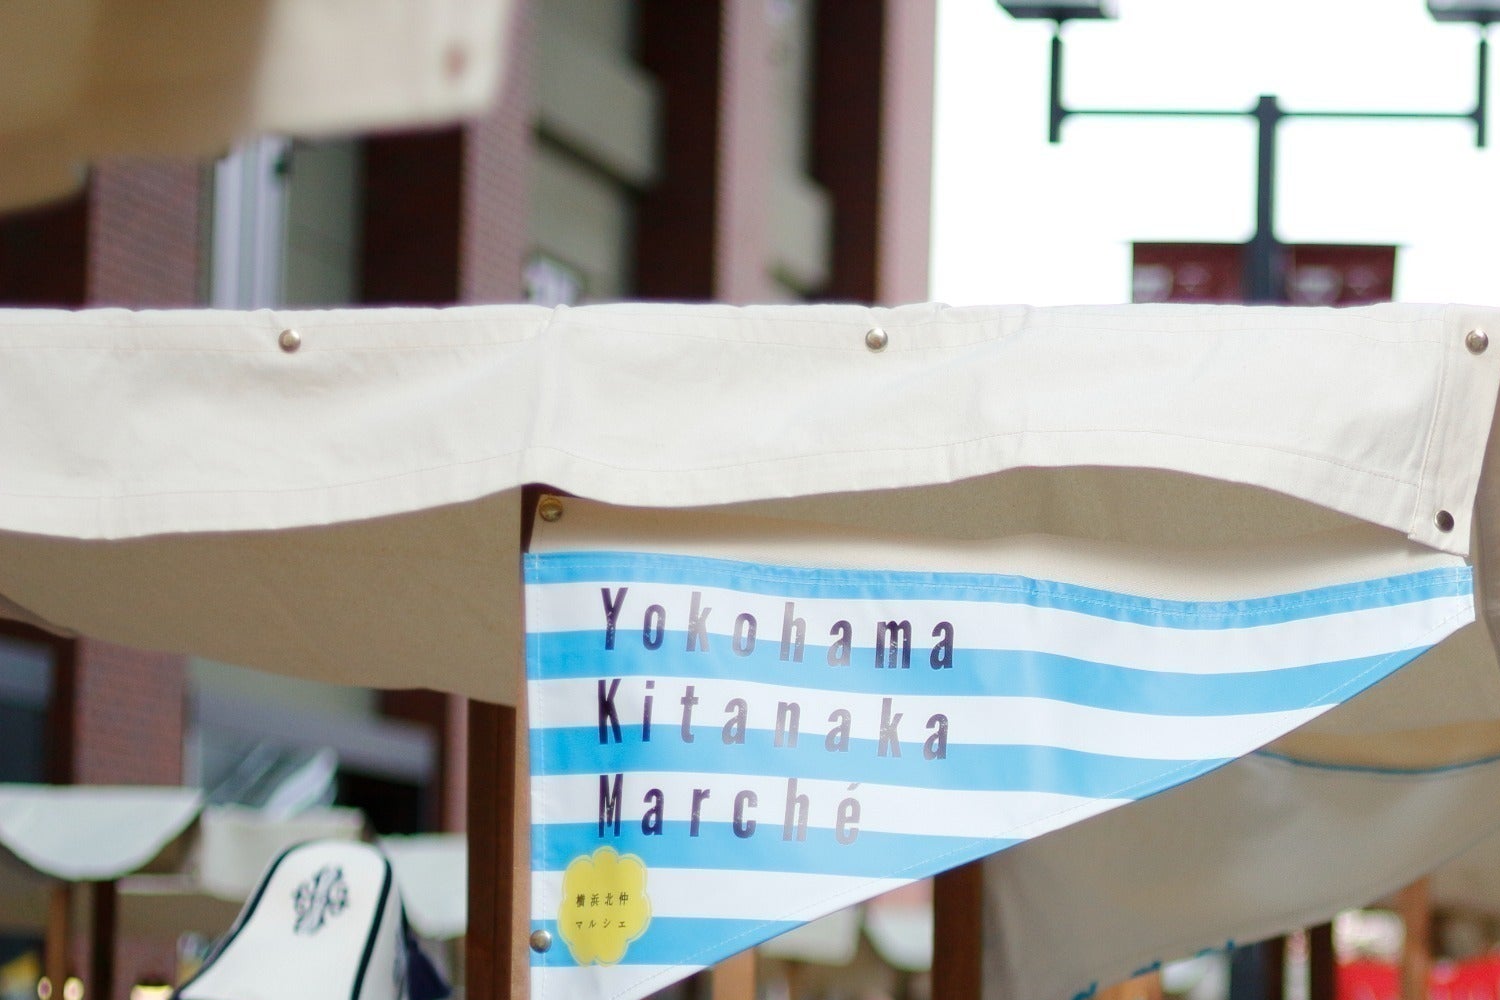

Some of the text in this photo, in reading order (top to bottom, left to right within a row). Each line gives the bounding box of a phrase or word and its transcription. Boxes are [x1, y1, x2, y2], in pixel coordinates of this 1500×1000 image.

[601, 587, 954, 670] Yokohama
[598, 679, 949, 760] Kitanaka
[598, 774, 861, 845] Marché
[576, 892, 629, 907] 横浜北仲
